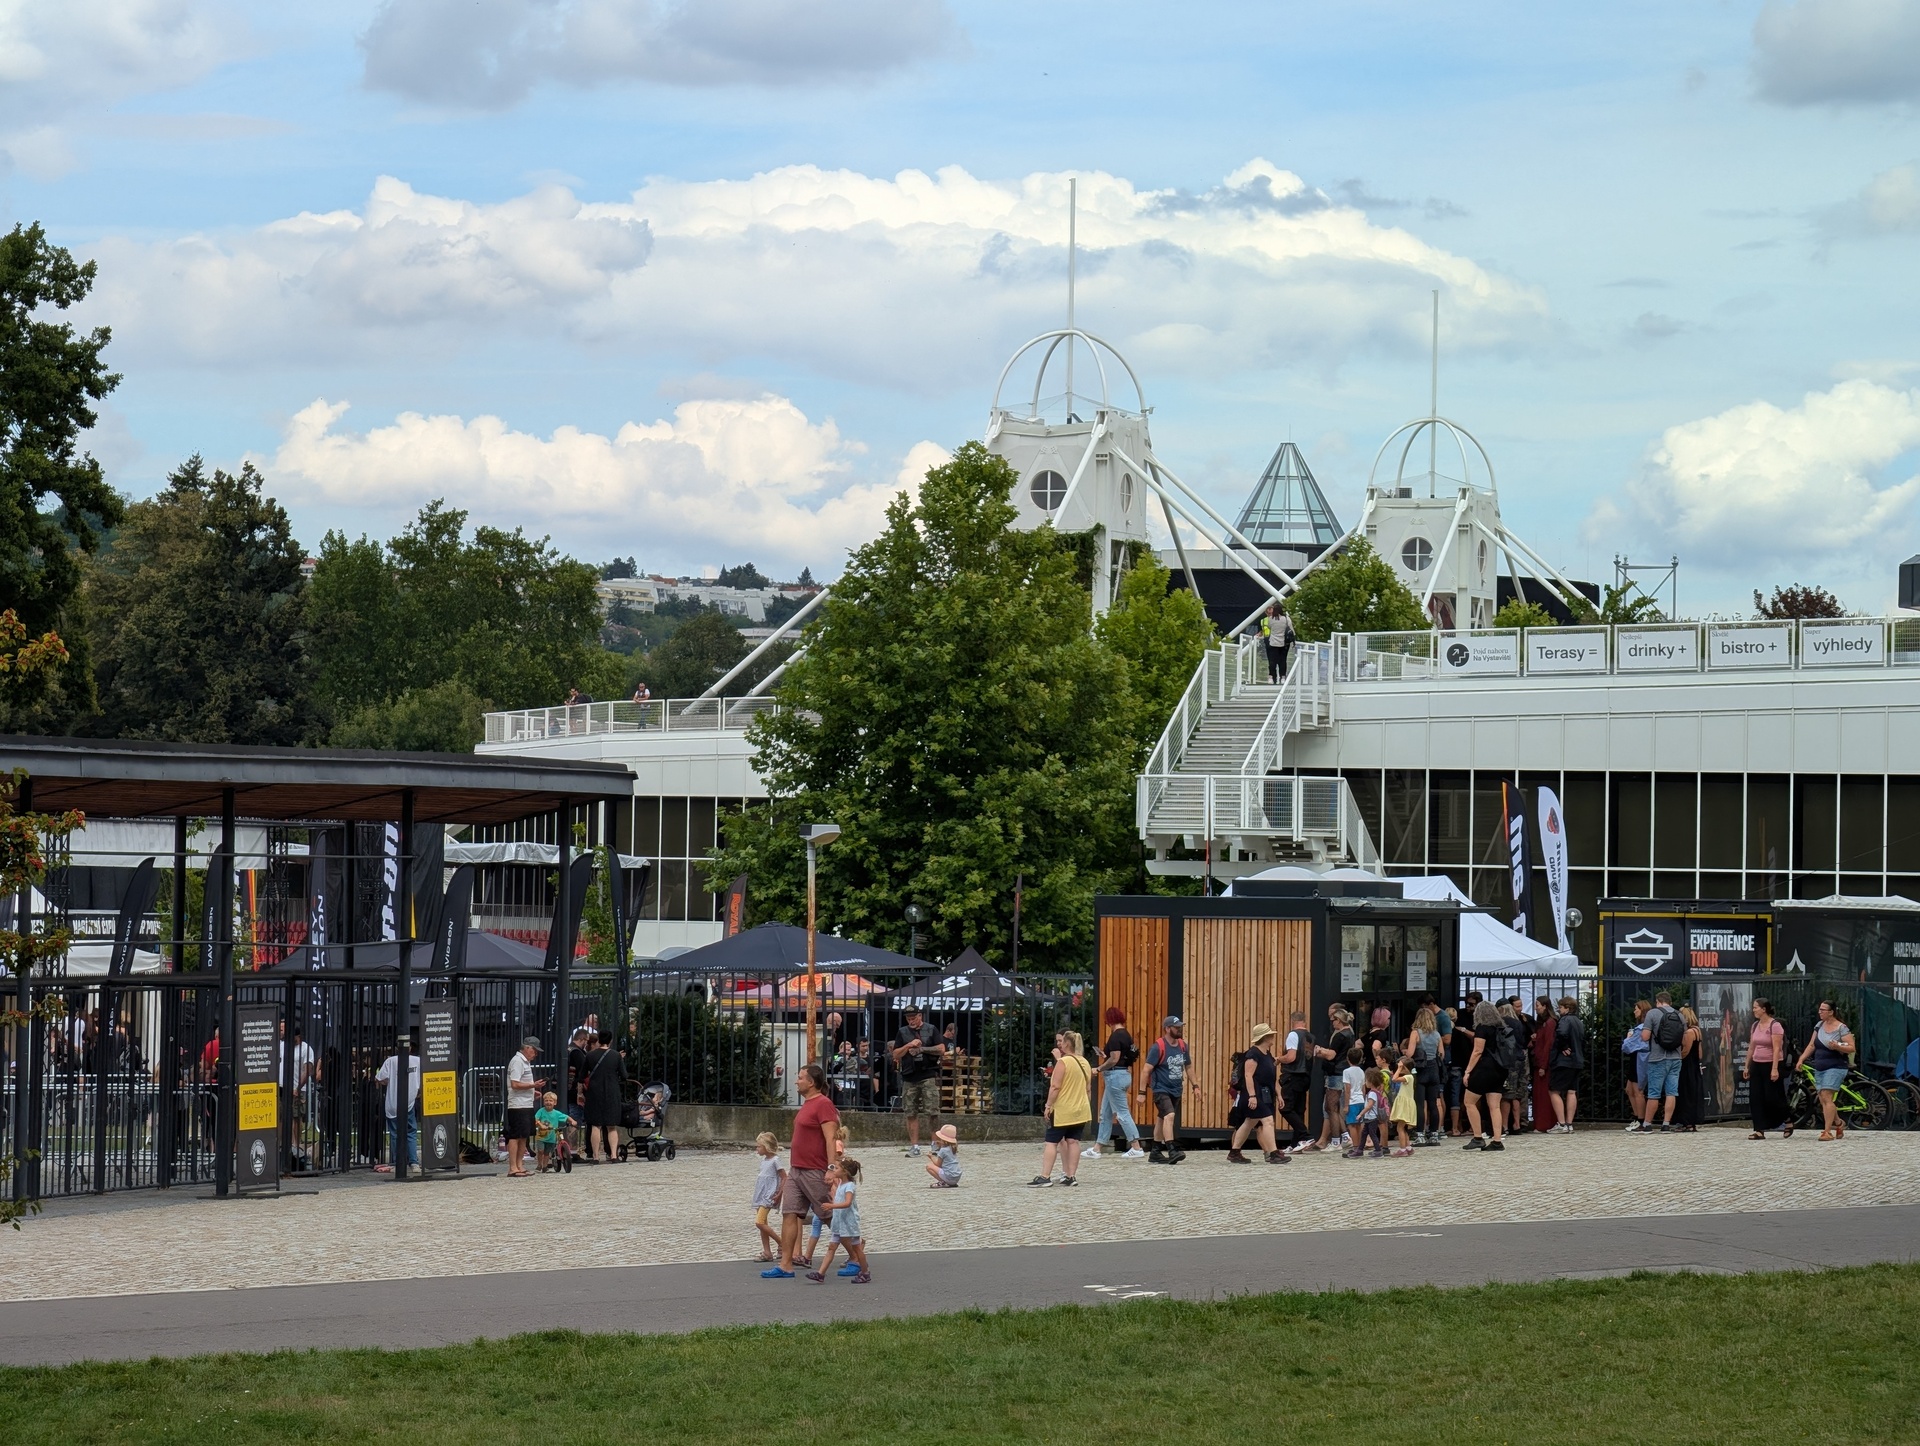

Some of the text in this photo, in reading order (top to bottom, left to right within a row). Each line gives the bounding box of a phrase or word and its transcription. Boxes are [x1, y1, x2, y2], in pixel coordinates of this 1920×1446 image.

[1536, 646, 1585, 661] Terasy
[1628, 643, 1675, 659] drinky
[1721, 641, 1765, 654] bistro
[1813, 637, 1873, 655] výhledy
[729, 893, 741, 937] ROYAL
[1690, 934, 1755, 951] EXPERIENCE
[1690, 951, 1719, 967] TOUR
[892, 996, 983, 1011] SUPER73
